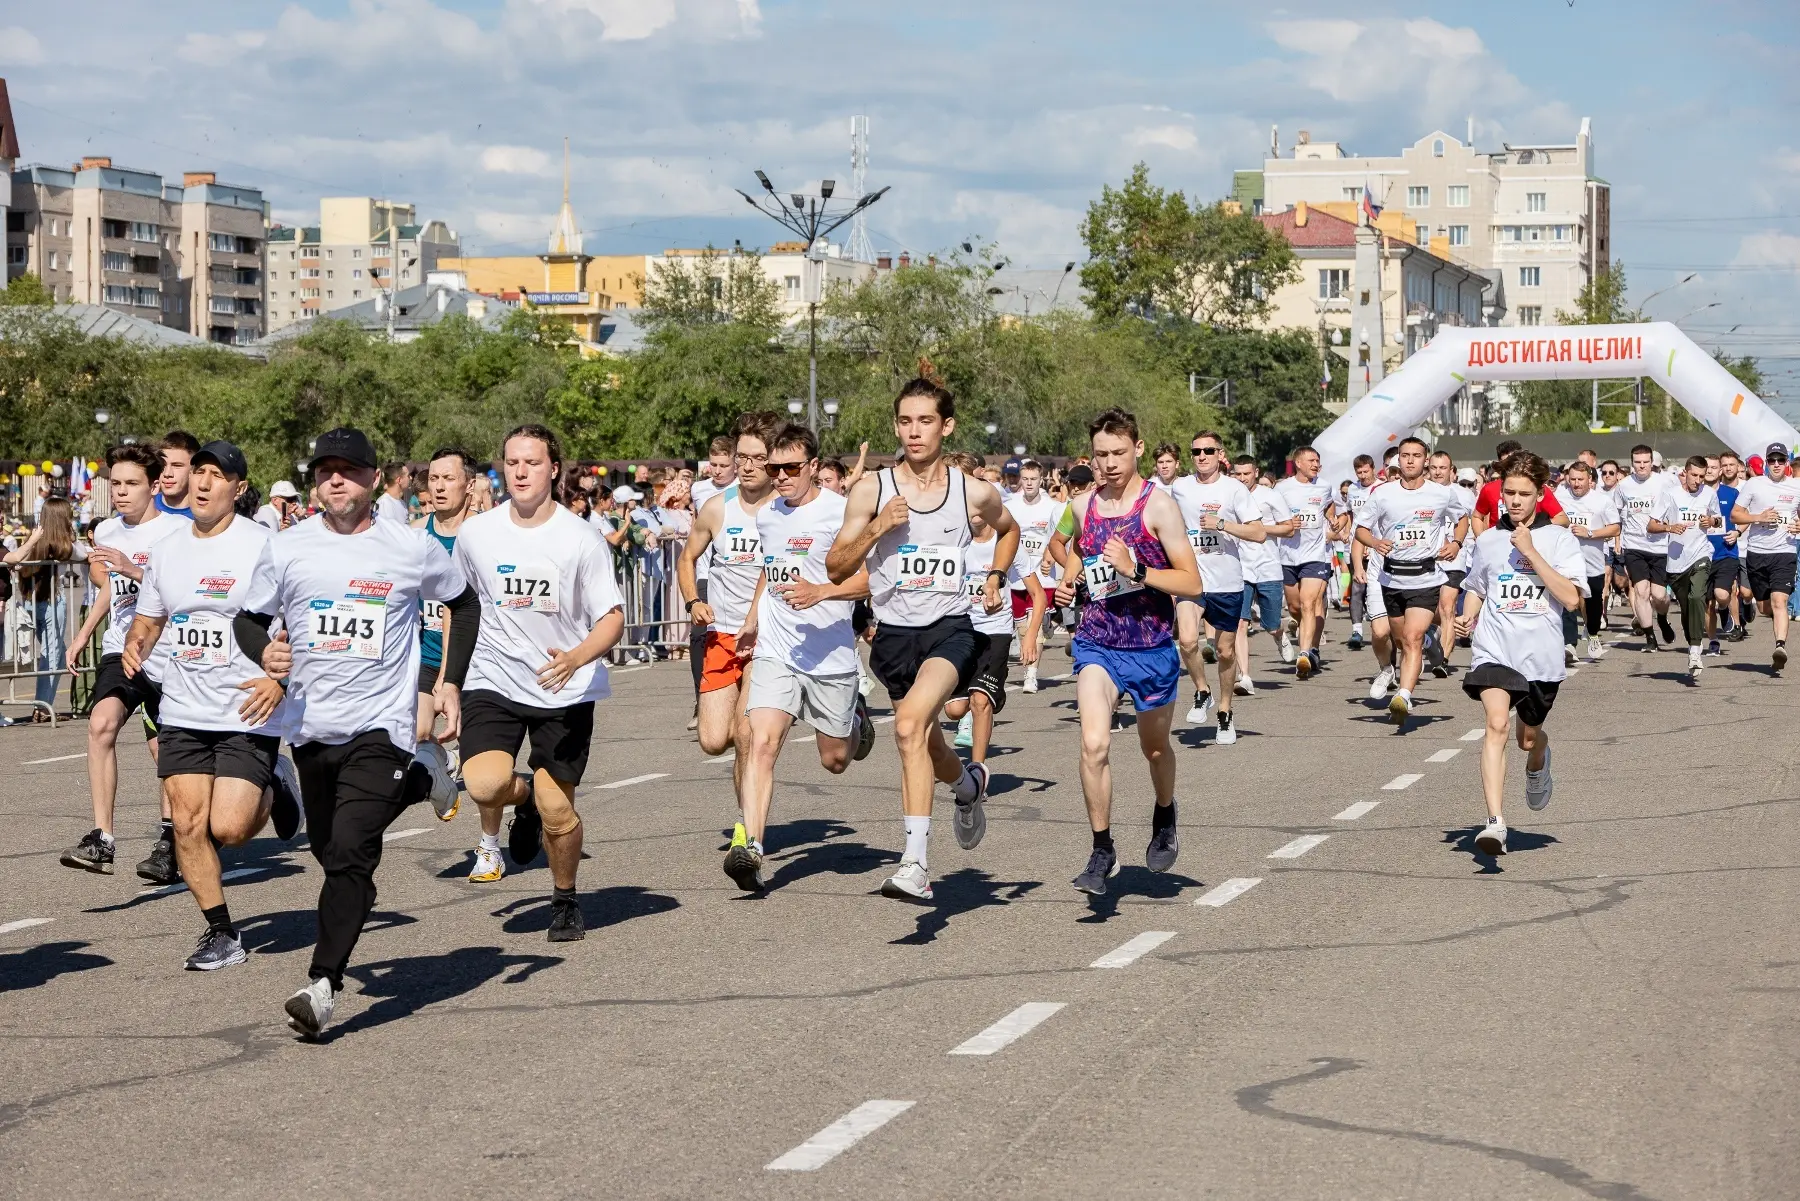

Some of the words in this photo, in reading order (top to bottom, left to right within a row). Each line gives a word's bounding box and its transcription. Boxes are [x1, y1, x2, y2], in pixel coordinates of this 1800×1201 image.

[551, 293, 578, 302] РОССИИ
[1467, 339, 1572, 367] ДОСТИГАЯ
[1578, 336, 1642, 364] ЦЕЛИ!
[1193, 536, 1219, 547] 1121
[1399, 530, 1426, 541] 1312
[731, 537, 764, 554] 117
[901, 557, 956, 577] 1070
[352, 580, 391, 590] ДОСТИГАЯ
[361, 587, 389, 596] ЦЕЛИ!
[504, 577, 551, 597] 1172
[1500, 584, 1546, 600] 1047
[317, 614, 375, 640] 1143
[177, 627, 223, 649] 1013
